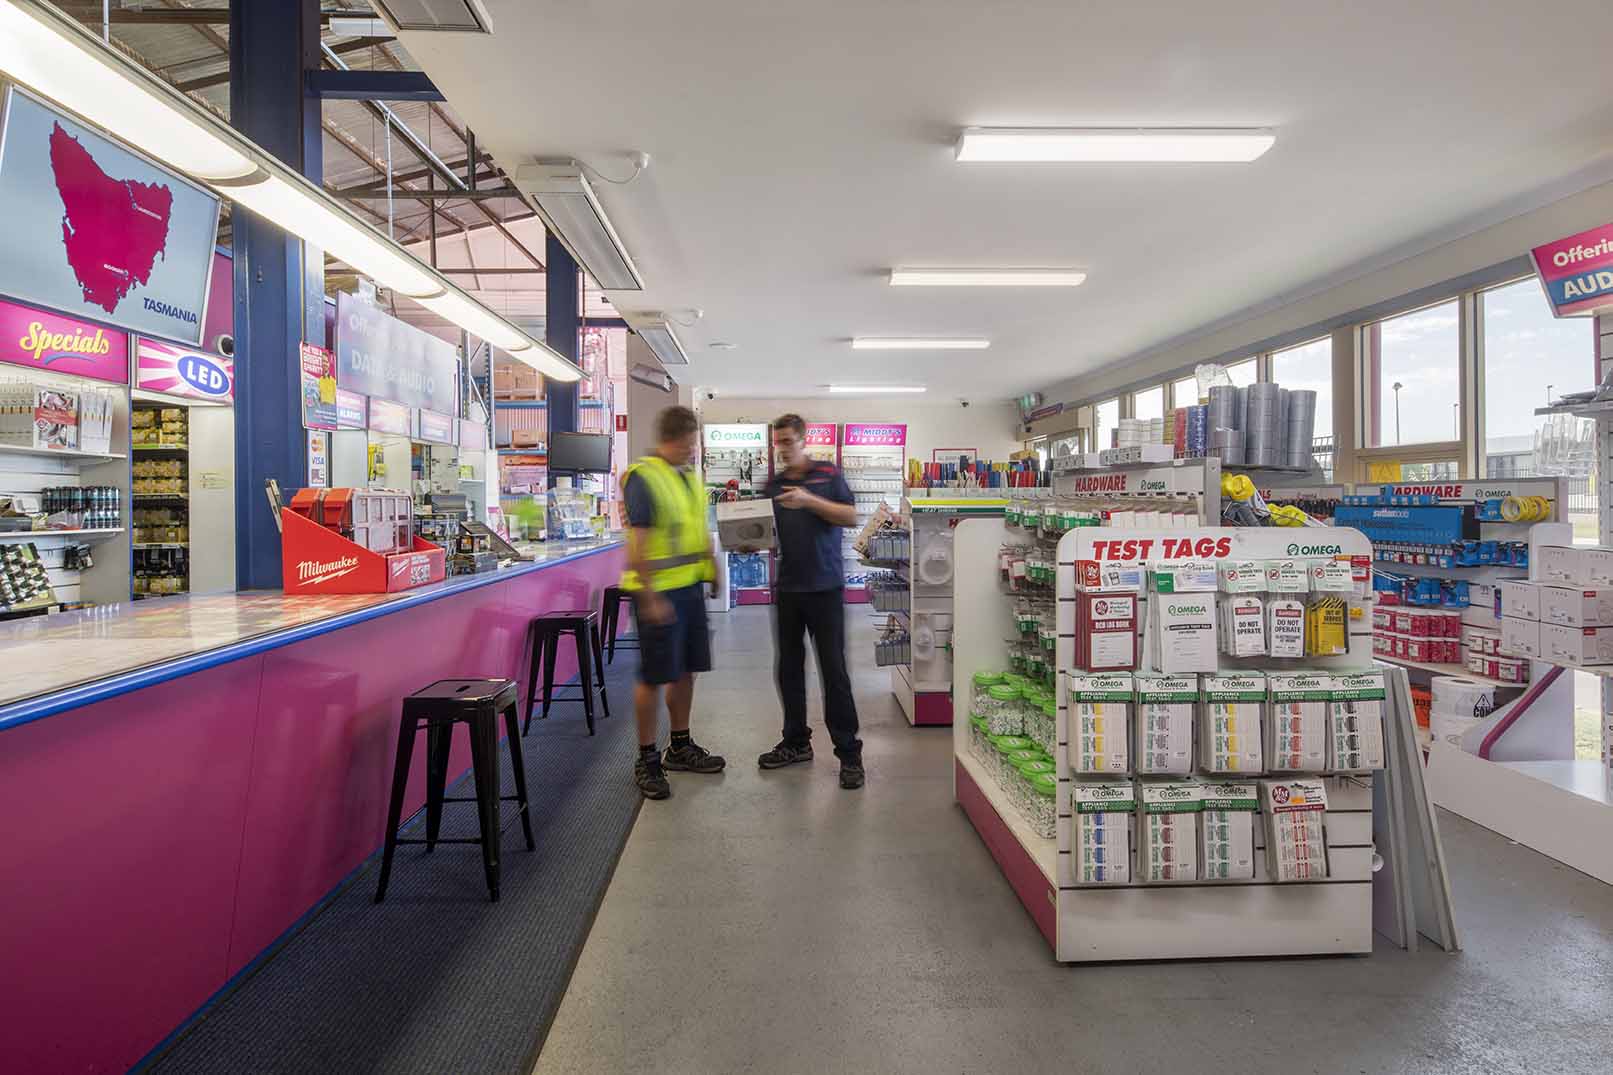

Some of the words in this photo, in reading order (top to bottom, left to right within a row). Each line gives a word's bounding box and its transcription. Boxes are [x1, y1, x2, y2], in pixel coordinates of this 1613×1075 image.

[143, 297, 197, 325] TASMANIA
[20, 322, 111, 361] Specials
[187, 359, 223, 389] LED
[724, 432, 761, 440] OMEGA
[312, 456, 325, 465] VISA
[1075, 475, 1127, 492] HARDWARE
[1147, 480, 1166, 489] OMEGA
[1391, 485, 1463, 498] ARDWARE
[1485, 489, 1512, 497] OMEGA
[1093, 539, 1154, 560] TEST
[1162, 537, 1232, 559] TAGS
[1301, 544, 1342, 555] OMEGA
[296, 556, 360, 580] Milwaukee
